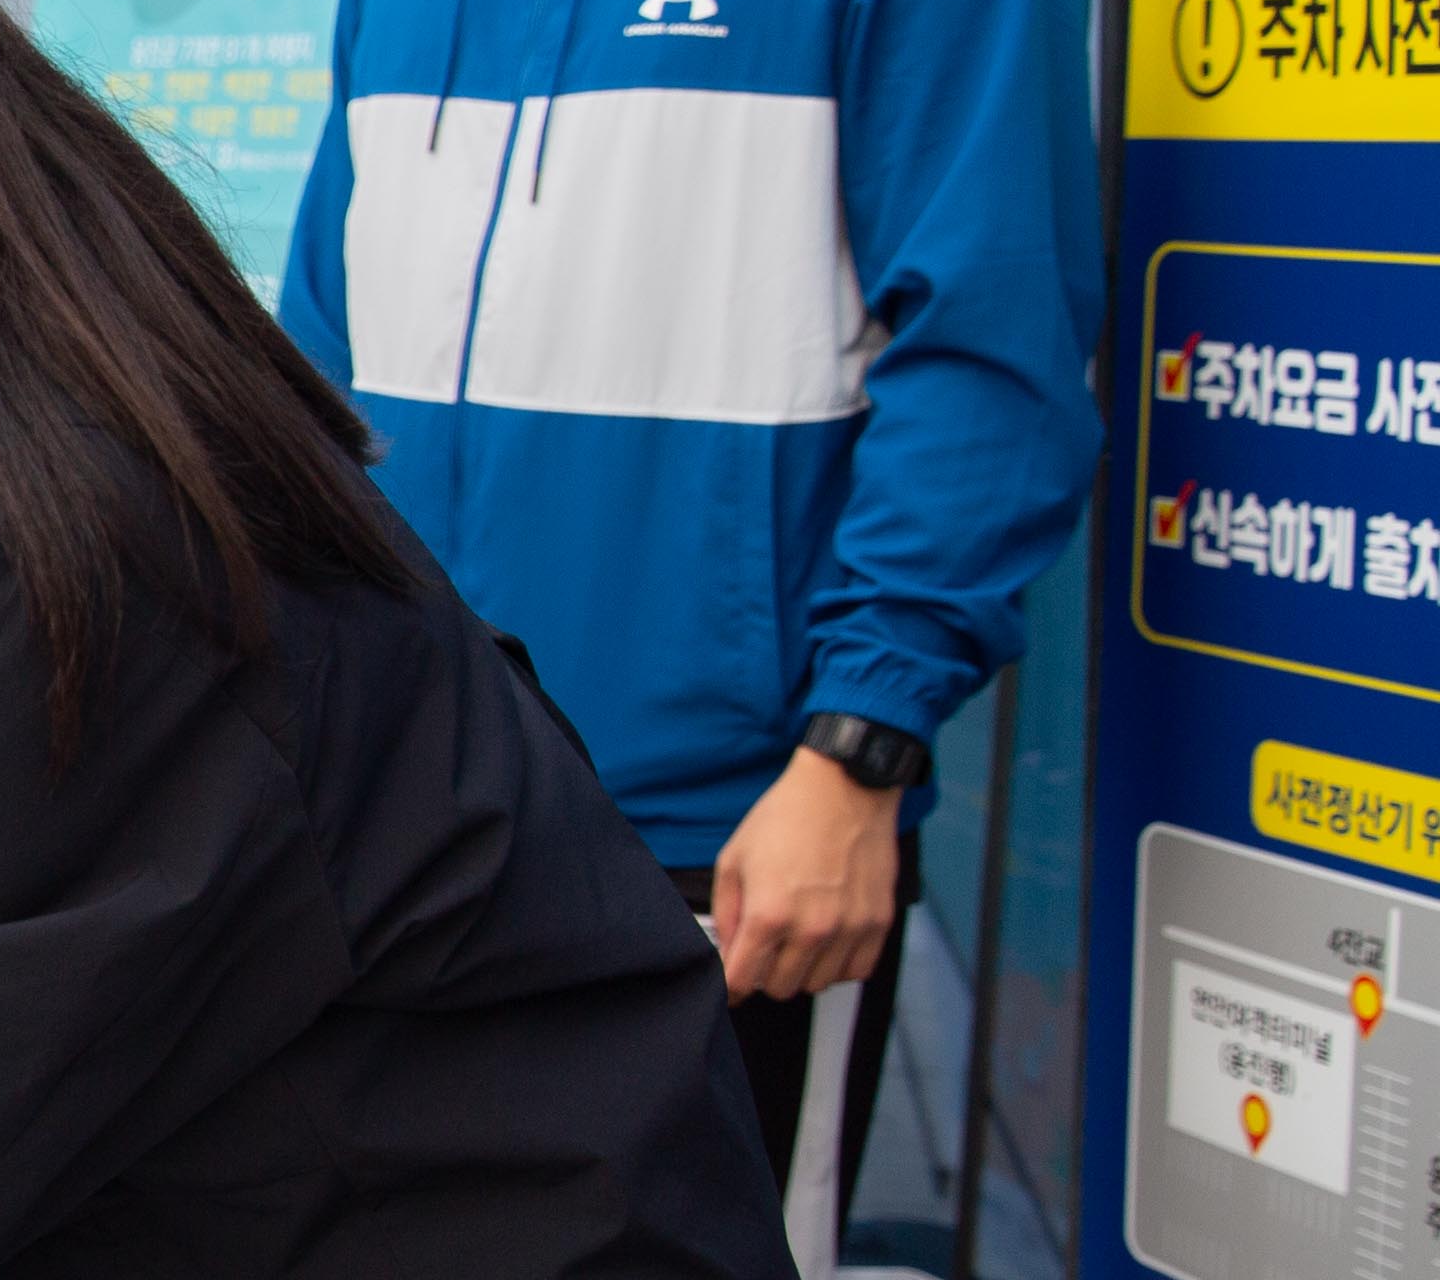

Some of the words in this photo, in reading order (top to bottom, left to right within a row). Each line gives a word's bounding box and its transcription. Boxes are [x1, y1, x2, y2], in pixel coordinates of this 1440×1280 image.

[1193, 340, 1359, 437] 주차요금
[1190, 488, 1356, 591] 신속하게
[1264, 770, 1412, 852] 사전정산기
